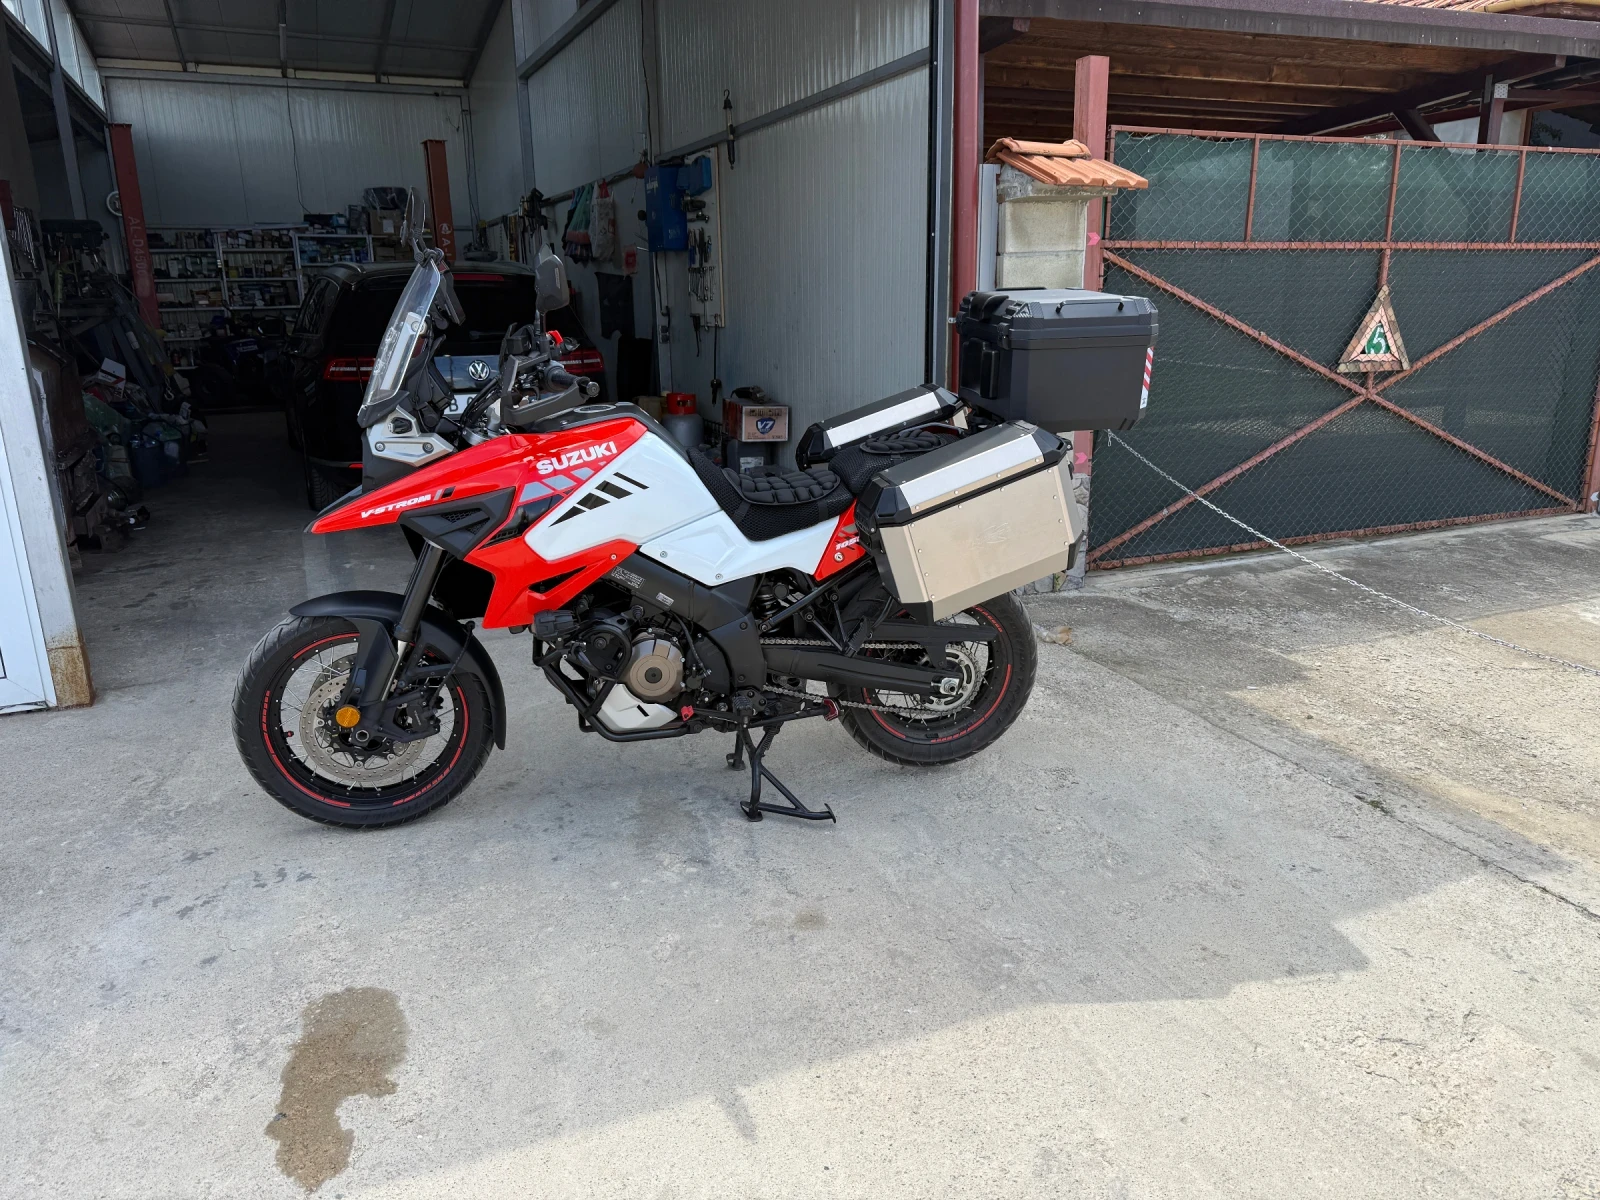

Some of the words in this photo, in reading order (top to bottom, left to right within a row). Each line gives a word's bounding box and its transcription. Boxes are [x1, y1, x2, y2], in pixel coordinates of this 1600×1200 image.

[757, 420, 774, 430] V7
[536, 441, 618, 475] SUZUKI
[360, 494, 432, 518] V-STROM
